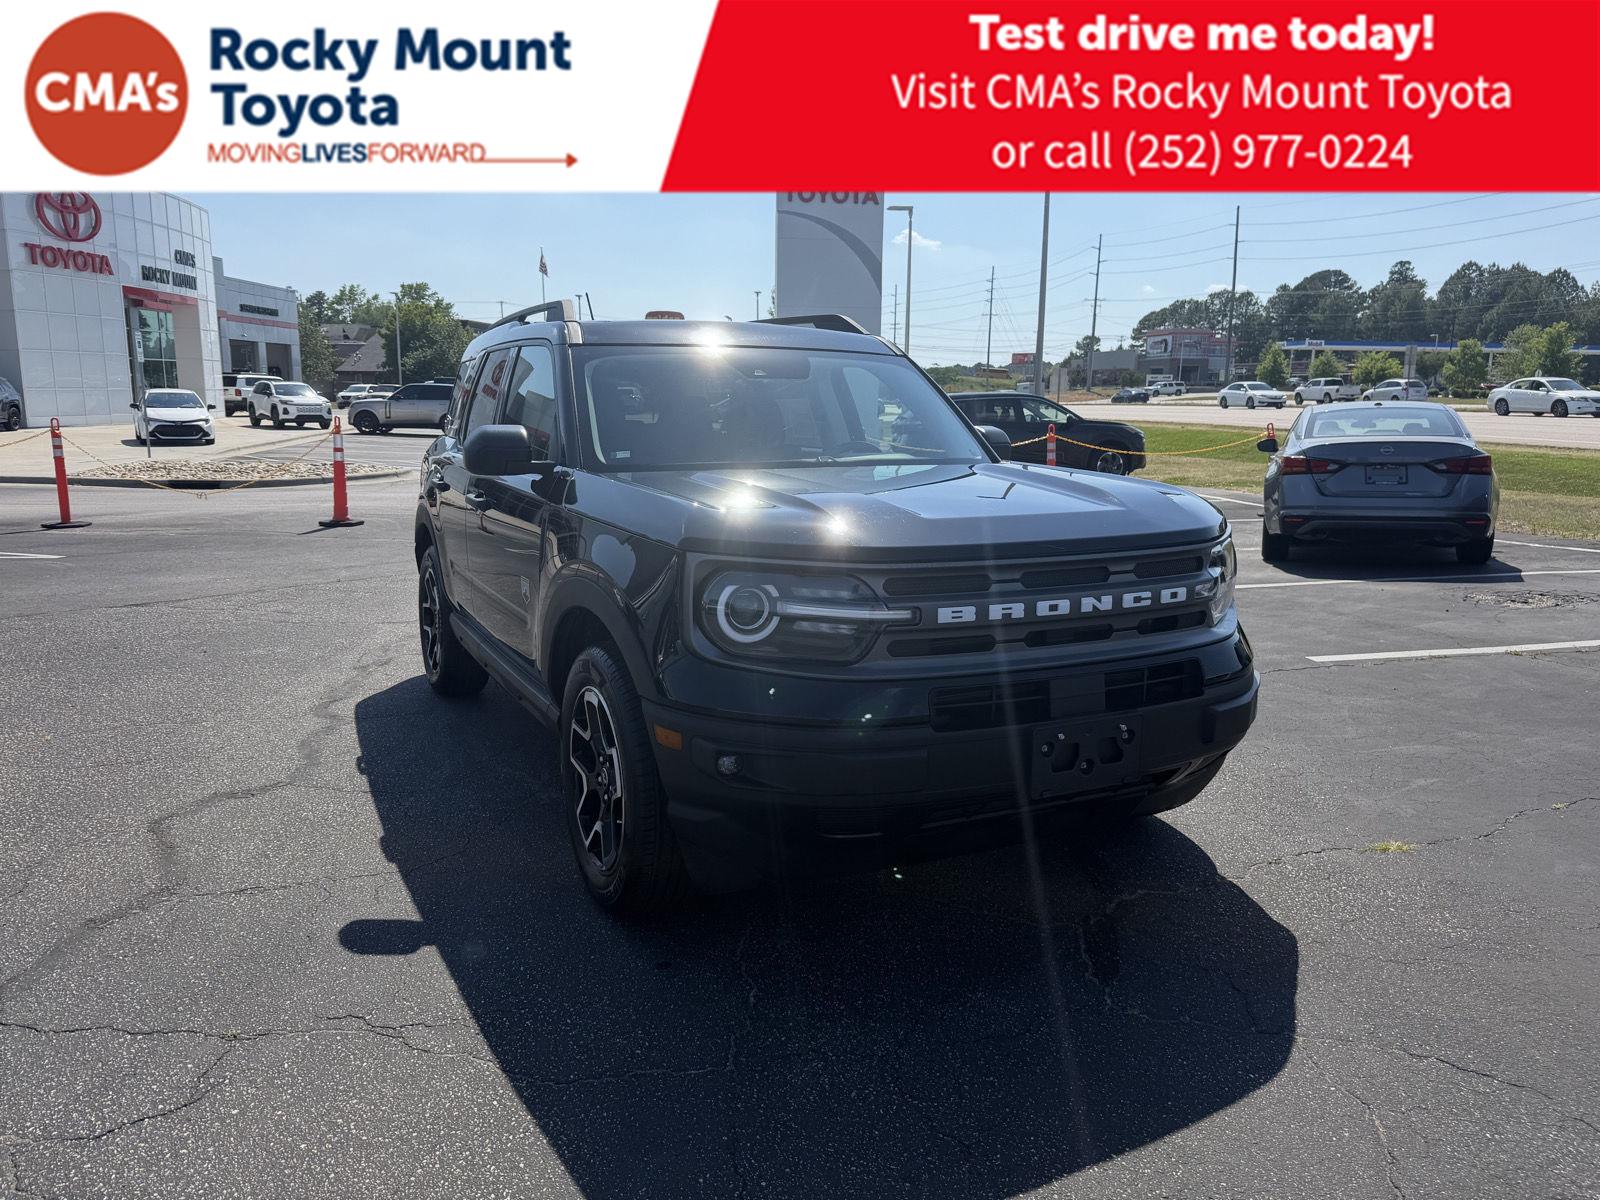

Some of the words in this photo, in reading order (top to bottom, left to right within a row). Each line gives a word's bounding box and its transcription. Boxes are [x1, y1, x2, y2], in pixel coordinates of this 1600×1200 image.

[24, 242, 114, 276] TOYOTA
[141, 265, 170, 285] ROCKY
[937, 586, 1187, 624] BRONCO
